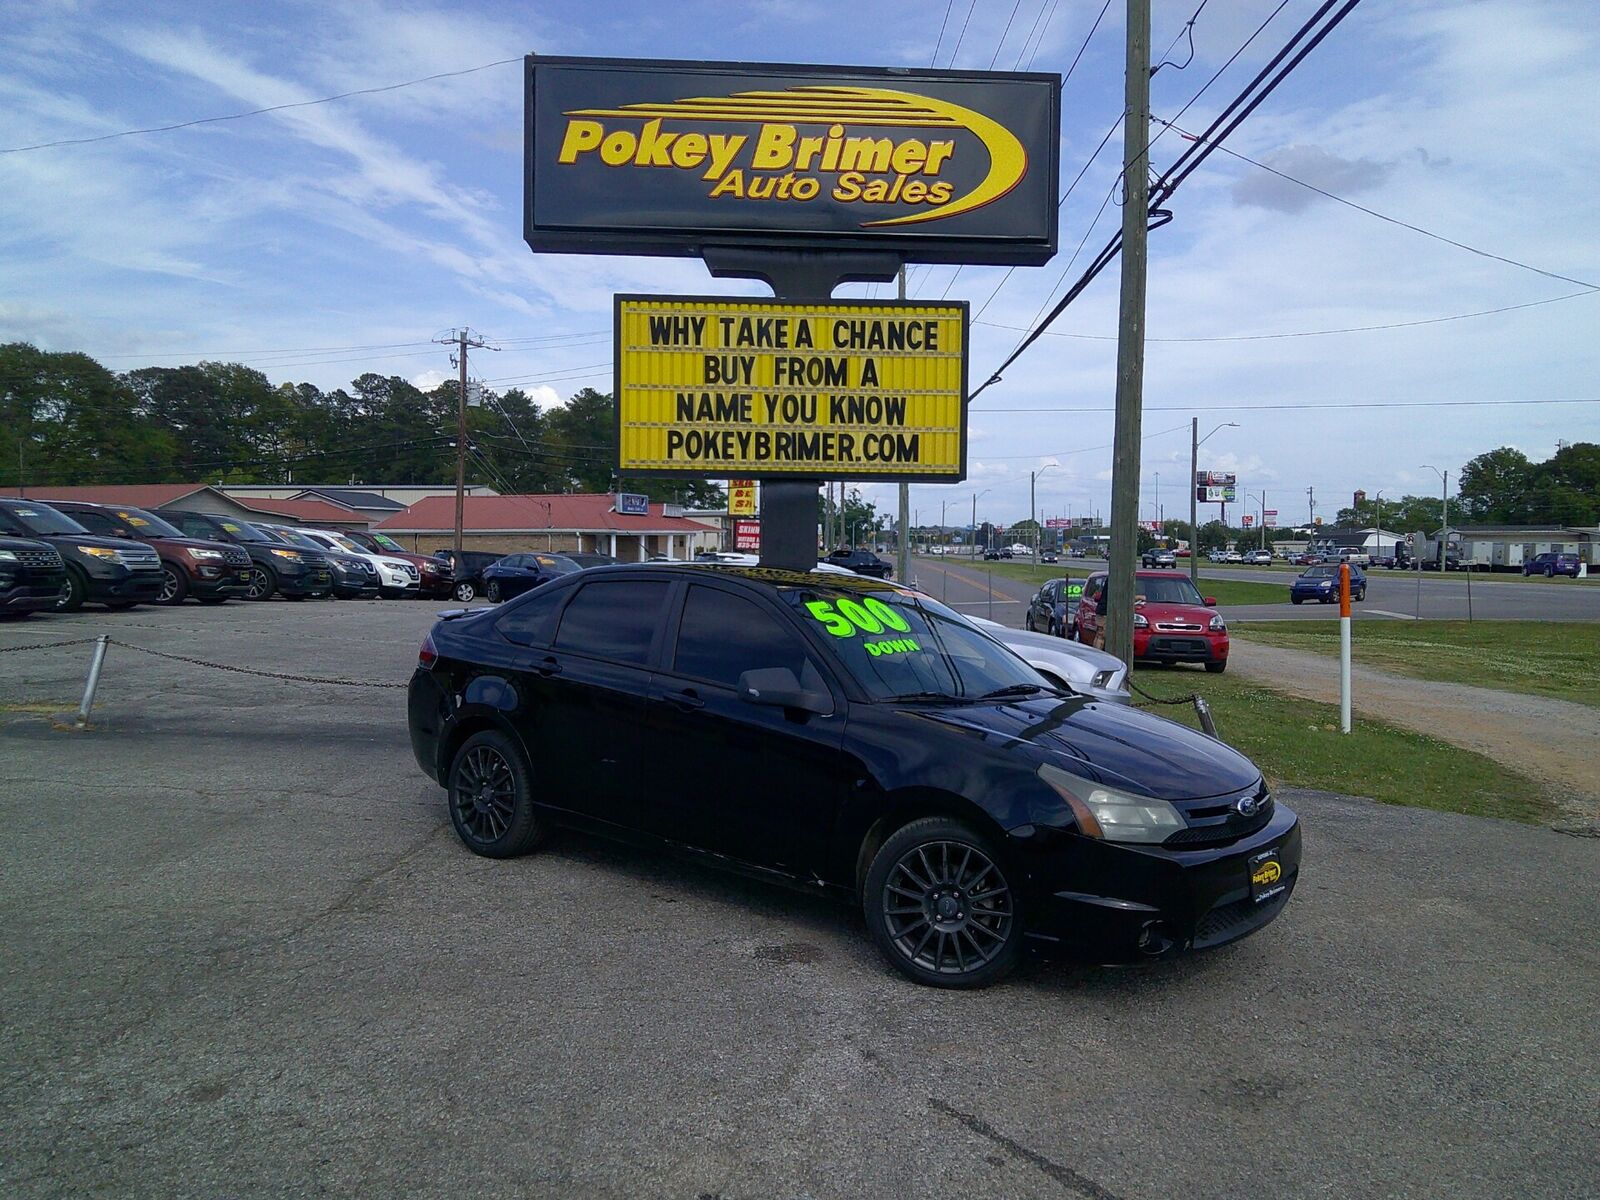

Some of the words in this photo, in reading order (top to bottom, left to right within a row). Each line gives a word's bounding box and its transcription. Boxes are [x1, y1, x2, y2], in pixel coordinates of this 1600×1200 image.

[557, 118, 749, 182] Pokey
[751, 123, 956, 176] Brimer
[708, 168, 821, 201] Auto
[832, 172, 955, 204] Sales
[650, 316, 706, 346] WHY
[719, 318, 789, 348] TAKE
[795, 319, 814, 348] A
[832, 320, 938, 350] CHANCE
[704, 355, 756, 385] BUY
[774, 357, 848, 387] FROM
[860, 358, 879, 387] A
[676, 393, 753, 423] NAME
[764, 394, 817, 424] YOU
[829, 395, 907, 425] KNOW
[667, 430, 919, 462] POKEYBRIMER.COM
[804, 598, 911, 638] 500
[863, 639, 920, 657] DOWN
